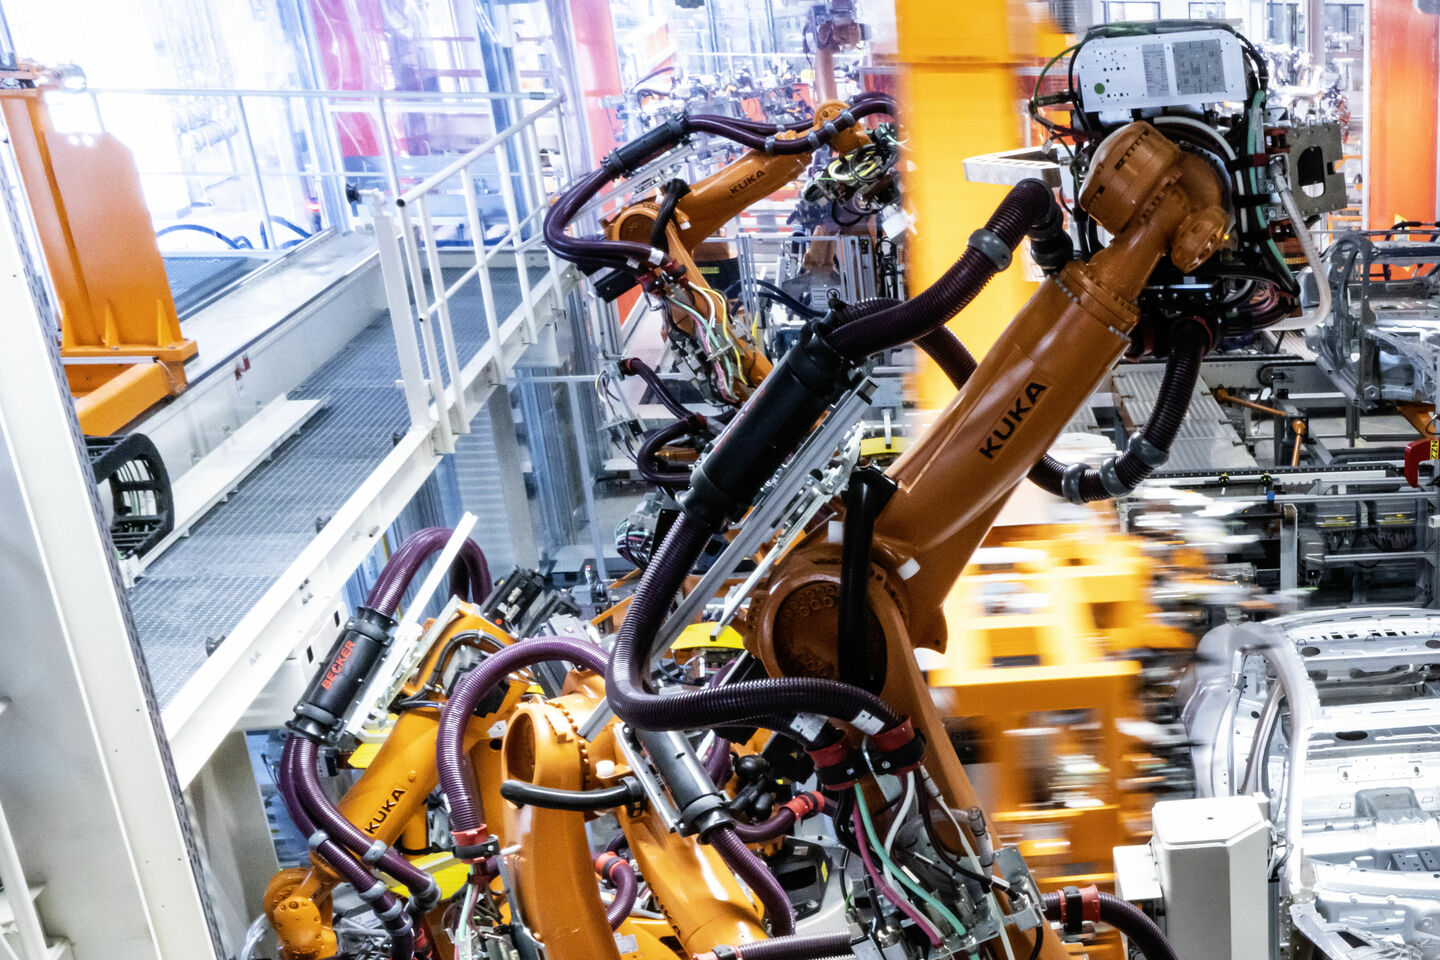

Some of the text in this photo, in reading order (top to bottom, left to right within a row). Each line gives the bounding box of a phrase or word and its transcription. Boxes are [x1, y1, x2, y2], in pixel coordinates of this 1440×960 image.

[729, 169, 765, 194] KUKA
[979, 382, 1047, 459] KUKA
[321, 640, 356, 690] BECKER
[364, 788, 405, 835] KUKA
